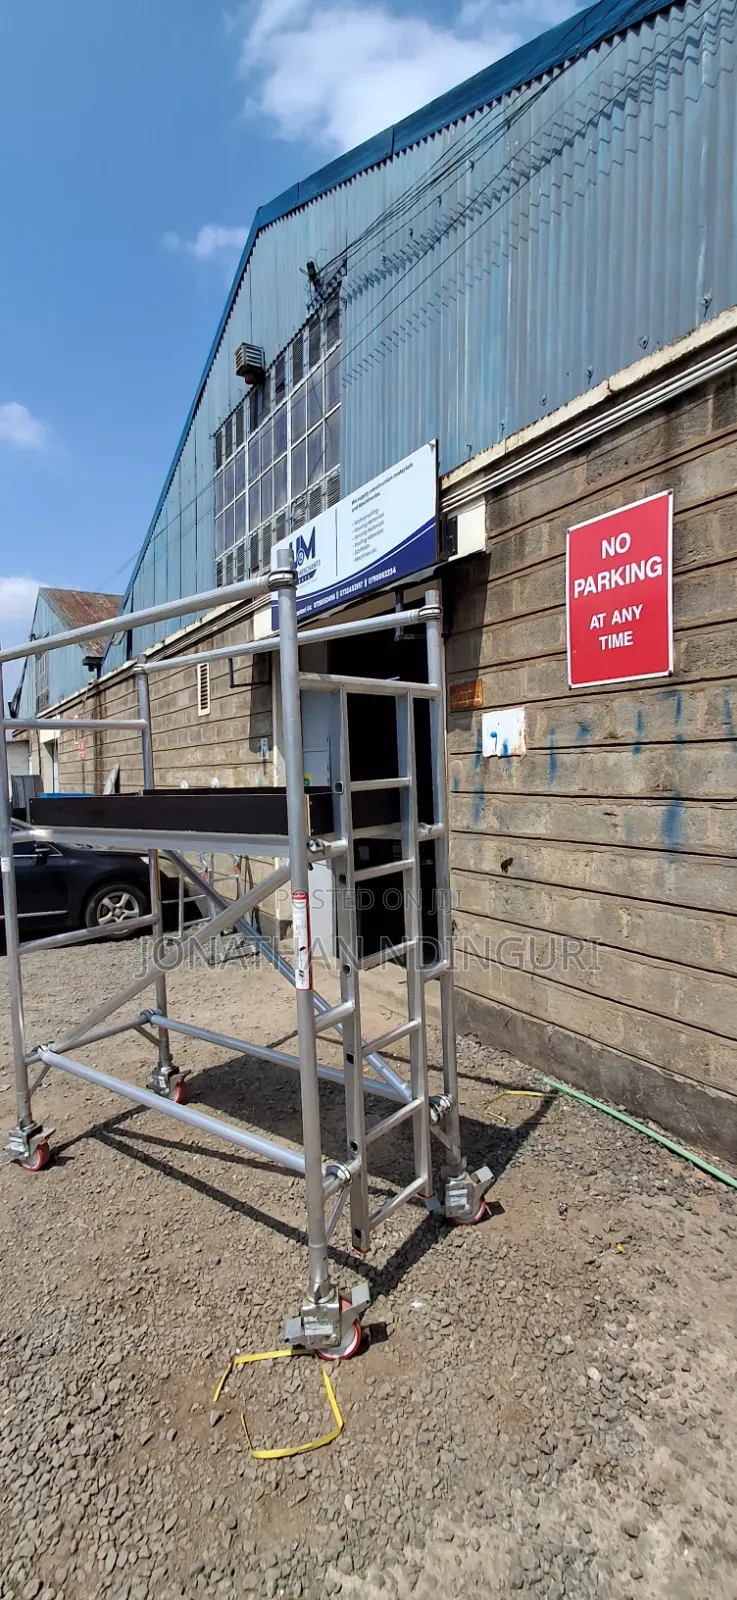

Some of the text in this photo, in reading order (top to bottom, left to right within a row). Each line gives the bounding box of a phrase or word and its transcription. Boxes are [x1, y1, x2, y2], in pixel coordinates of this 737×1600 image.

[601, 532, 631, 560] NO
[574, 556, 663, 599] PARKING
[590, 604, 644, 630] AT ANY
[599, 631, 634, 650] TIME
